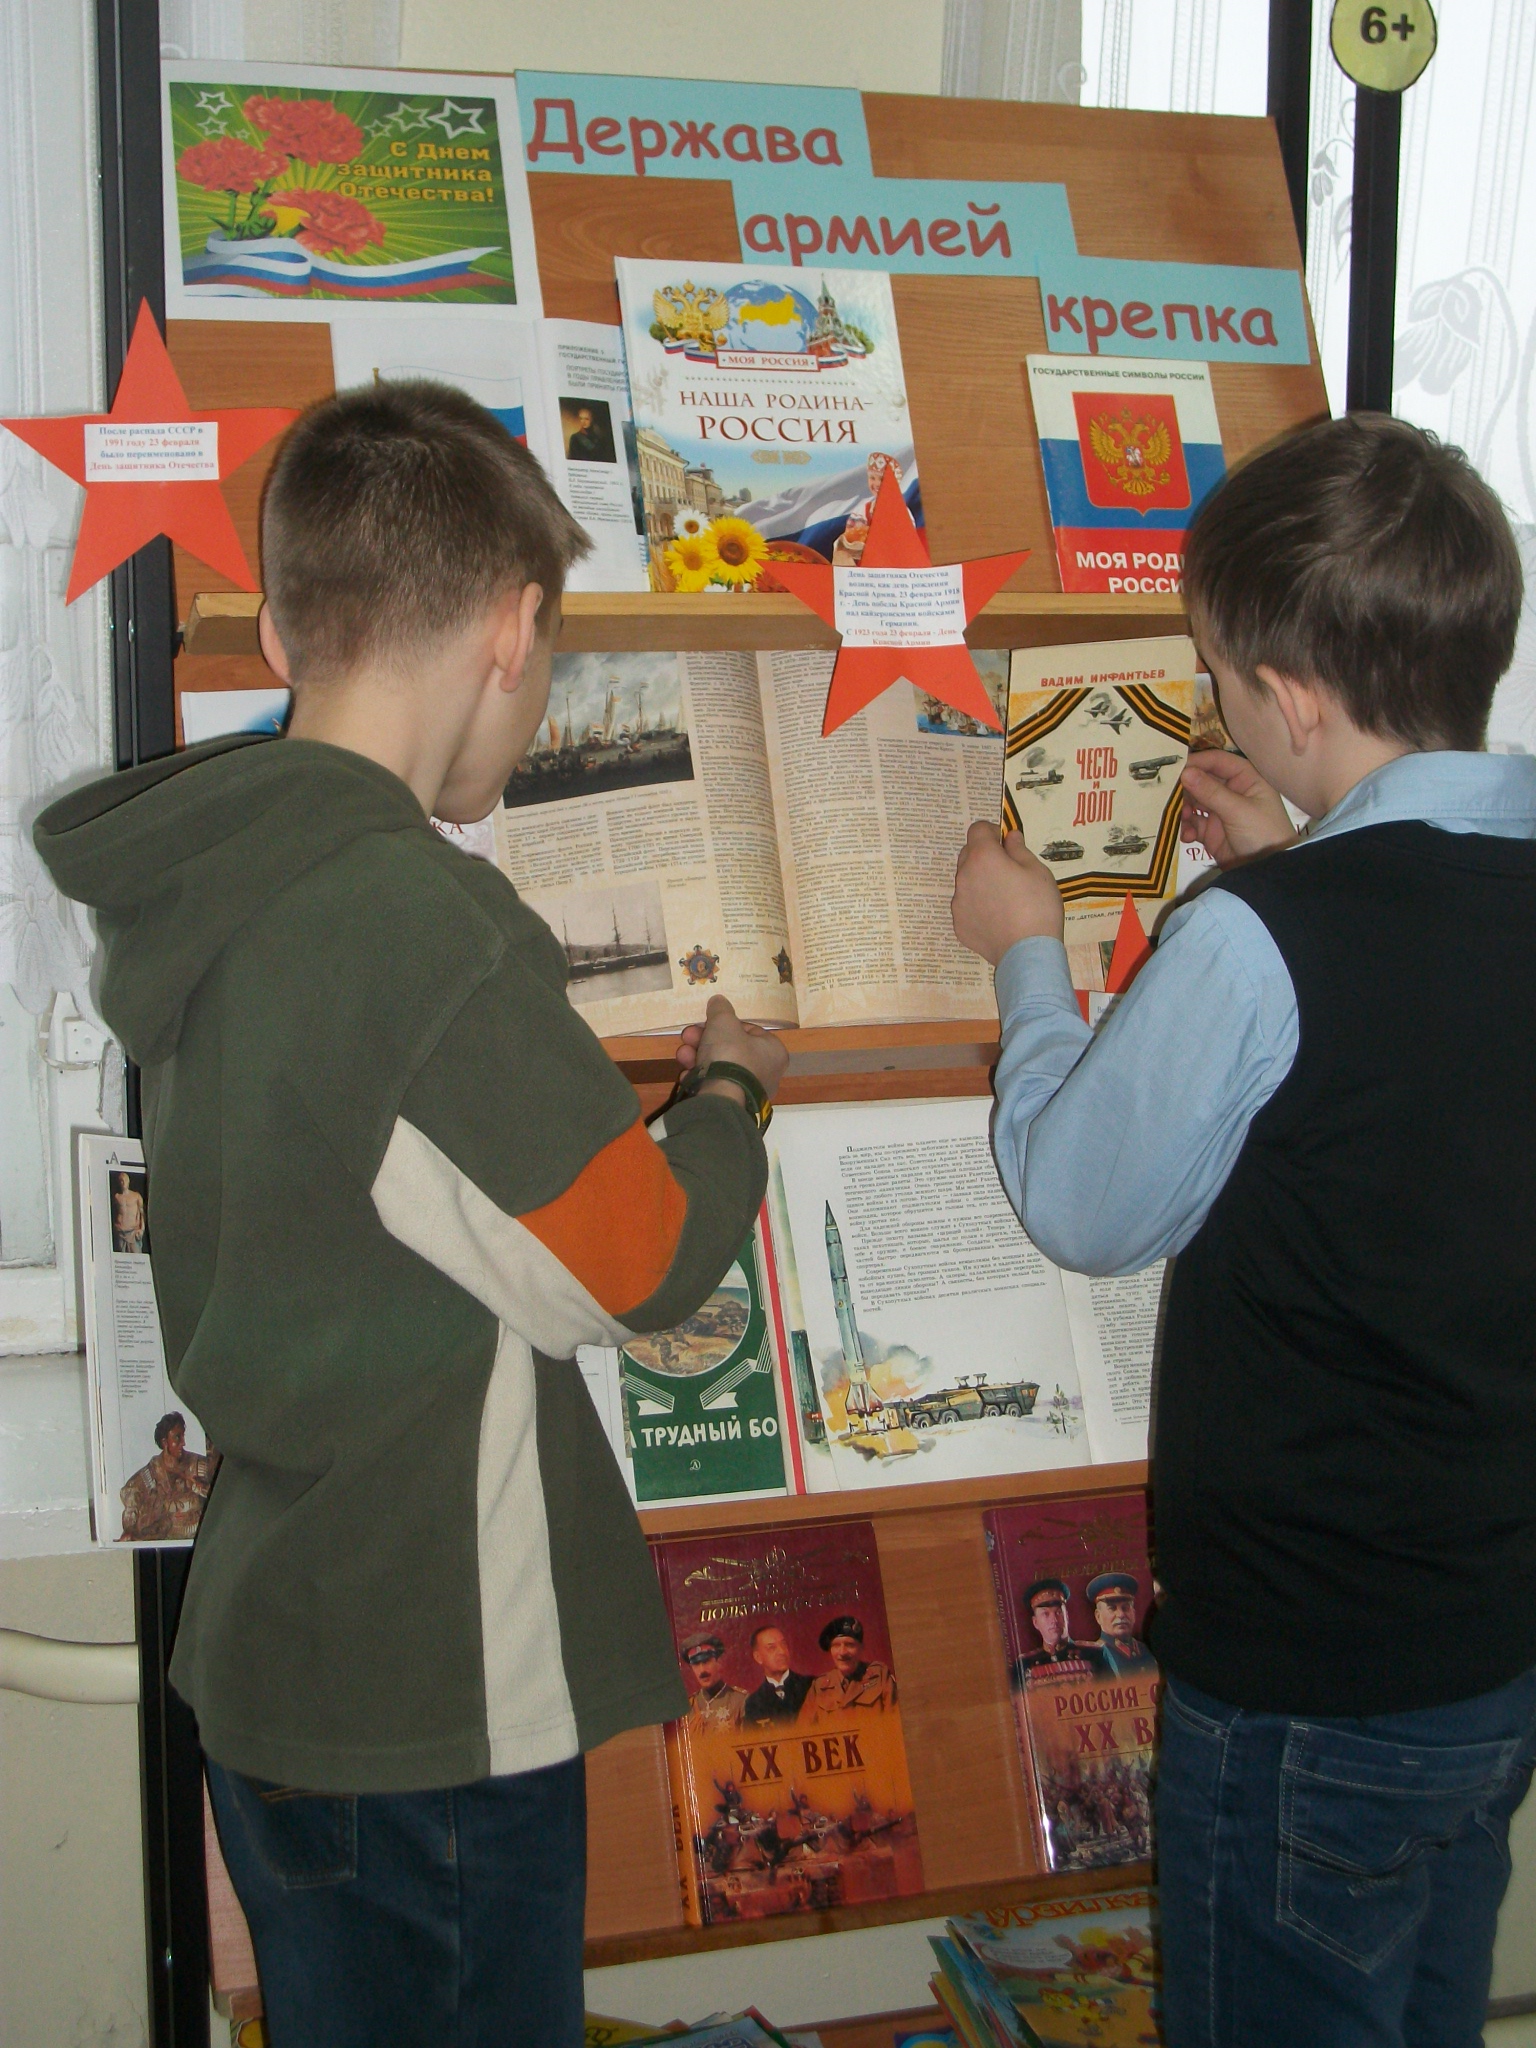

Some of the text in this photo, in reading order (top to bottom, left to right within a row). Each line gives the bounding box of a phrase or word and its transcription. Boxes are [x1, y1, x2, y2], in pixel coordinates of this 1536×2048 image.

[1360, 6, 1415, 43] 6+
[527, 98, 842, 177] Держава
[390, 141, 491, 161] С Днем
[337, 163, 493, 183] защитника
[339, 182, 495, 203] Отечества!
[743, 202, 1012, 267] армией
[1047, 293, 1278, 355] крепка
[728, 355, 809, 367] МОЯ РОССИЯ
[1033, 367, 1205, 381] ГОСУДАРСТВЕННЫЕ СИМВОЛЫ РОССИИ
[679, 390, 755, 408] НАША
[99, 427, 126, 435] После
[168, 426, 196, 434] СССР
[696, 415, 859, 444] РОССИЯ
[1076, 551, 1185, 573] МОЯ РОД
[909, 571, 949, 579] Отечества
[1040, 669, 1166, 688] ВАДИМ ИНФАНТЬЕВ
[1076, 746, 1118, 780] ЧЕСТЬ
[1072, 790, 1117, 827] ДОЛГ
[641, 1415, 742, 1447] ТРУДНЫЙ
[802, 1733, 865, 1773] ВЕК
